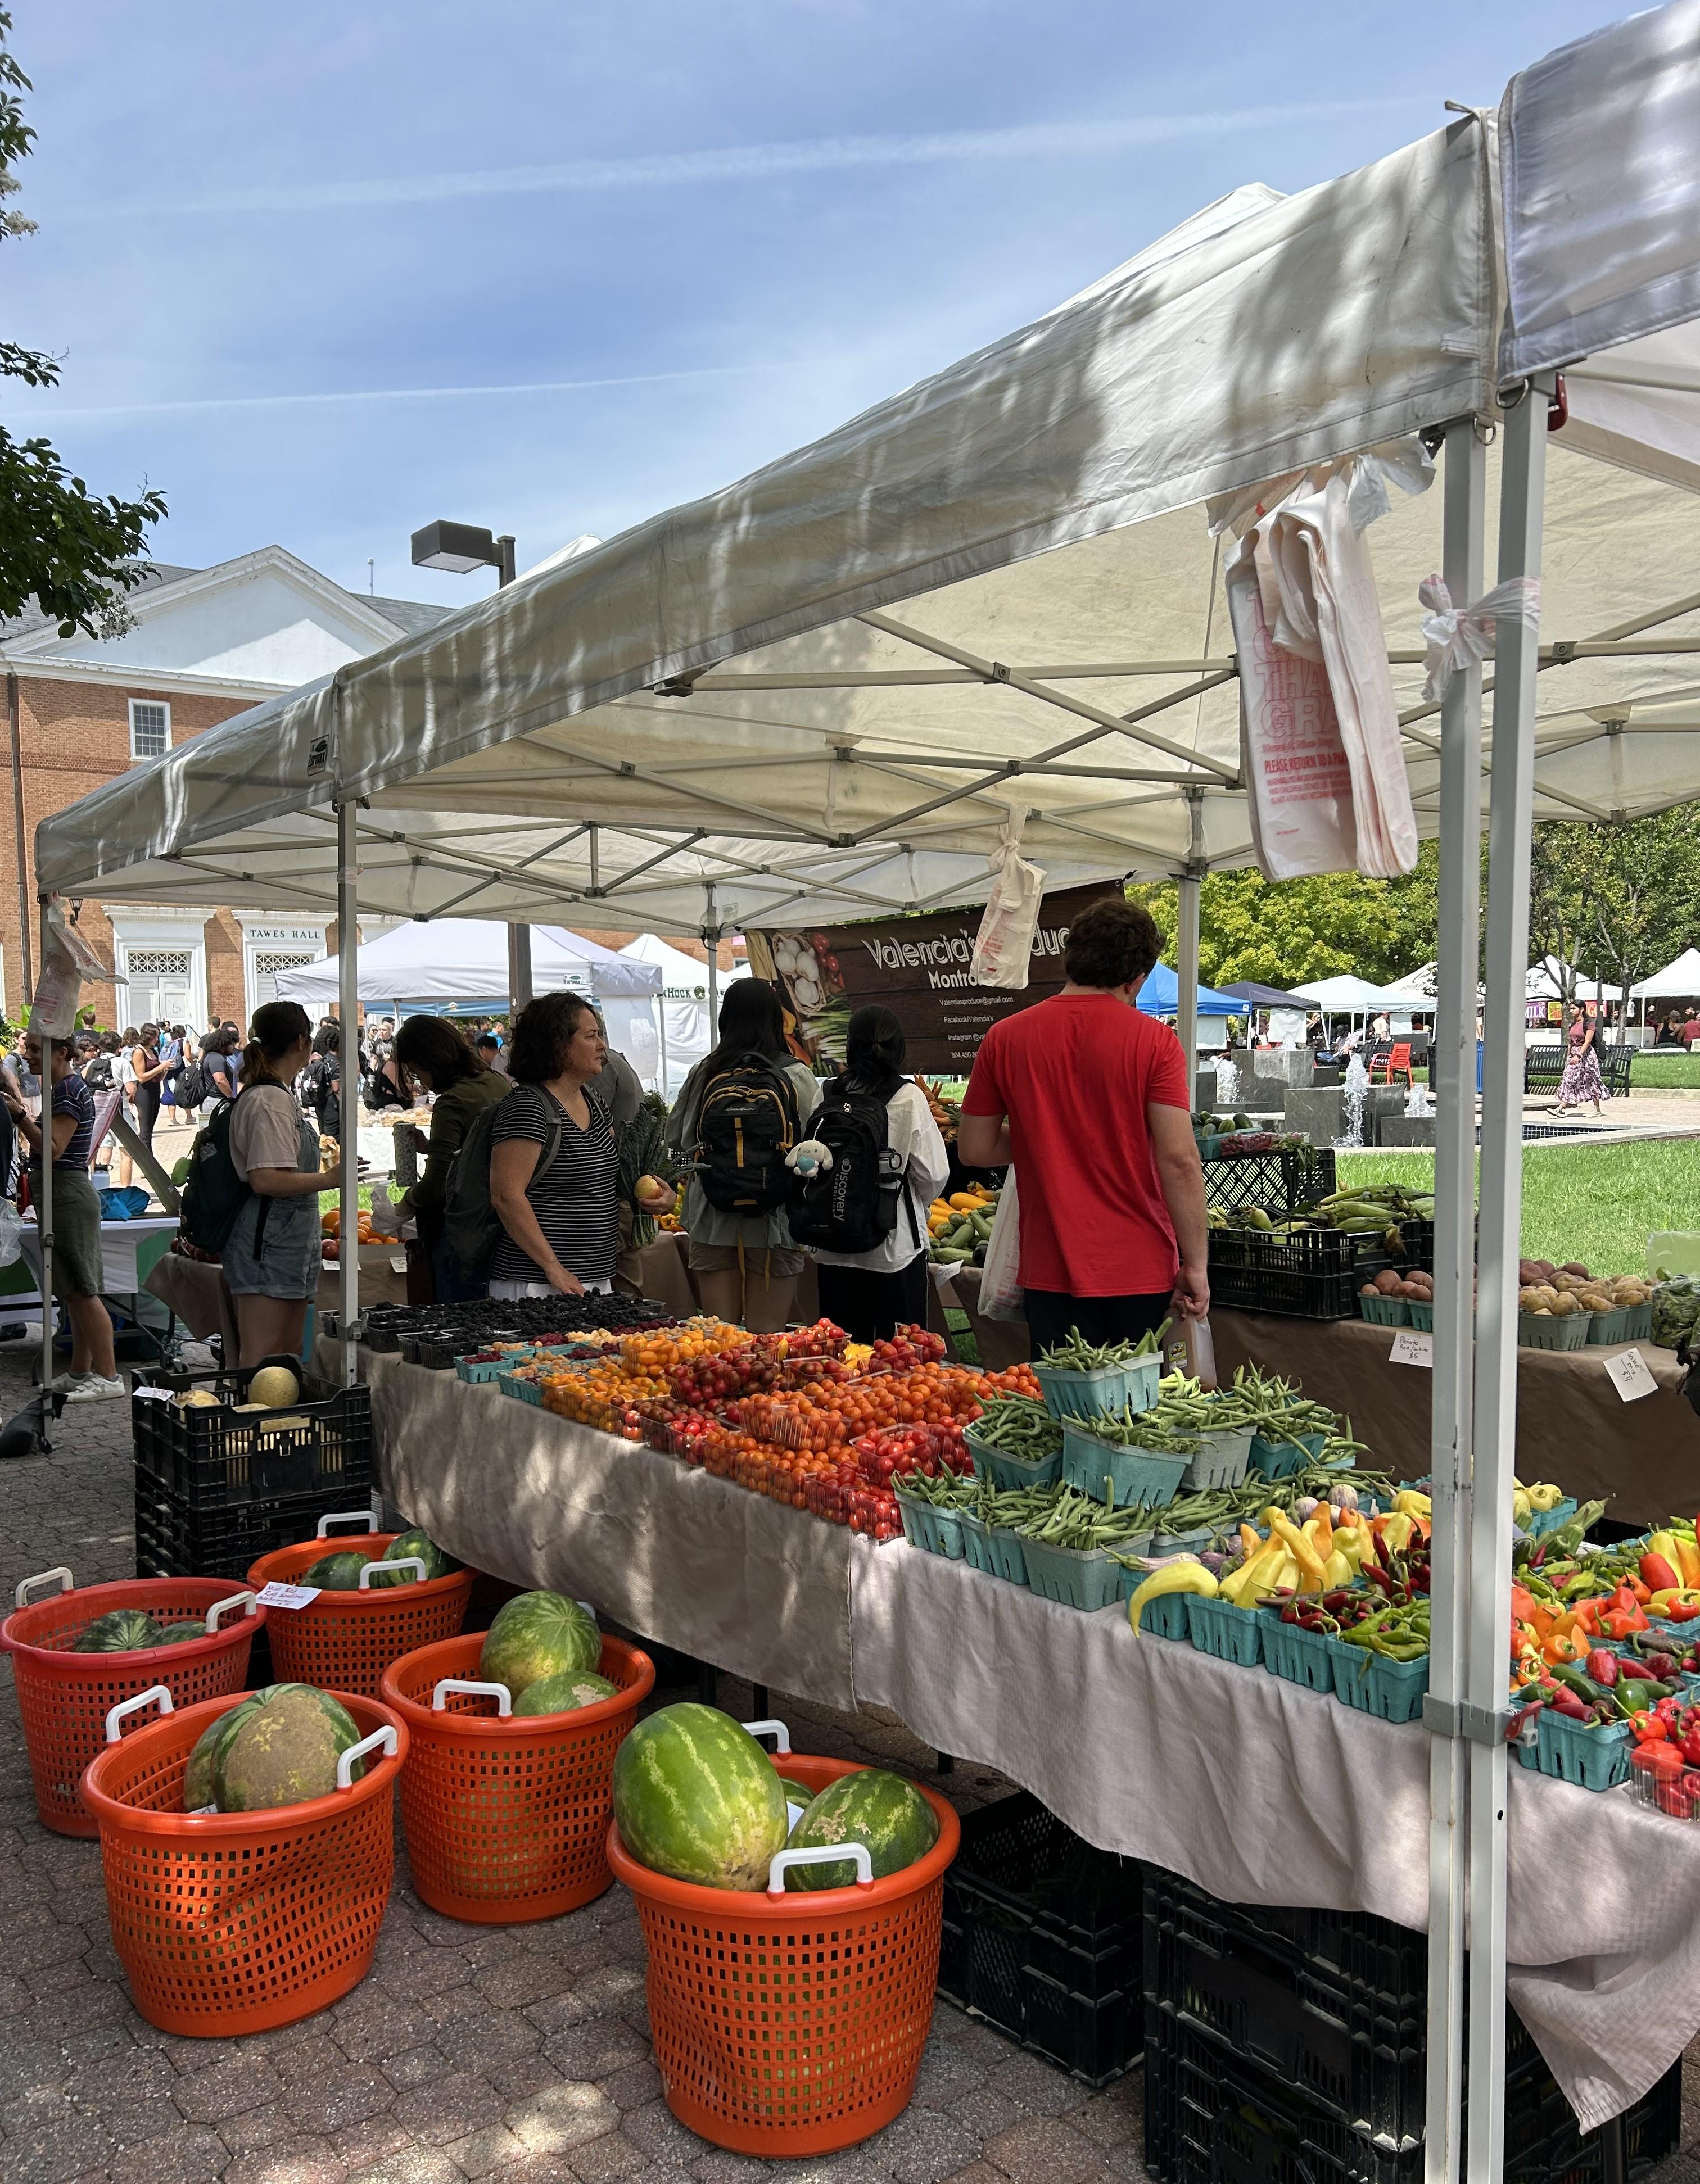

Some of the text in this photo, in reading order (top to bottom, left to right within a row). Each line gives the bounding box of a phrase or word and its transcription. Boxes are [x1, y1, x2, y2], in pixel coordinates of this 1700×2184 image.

[1254, 658, 1331, 701] THA
[1265, 758, 1288, 774] PLEASE
[1289, 755, 1316, 771] RETURN
[1317, 753, 1326, 768] TO
[1327, 753, 1332, 767] A
[250, 930, 285, 938] TAWES
[927, 968, 979, 989] Montro
[948, 1034, 973, 1042] Instagram
